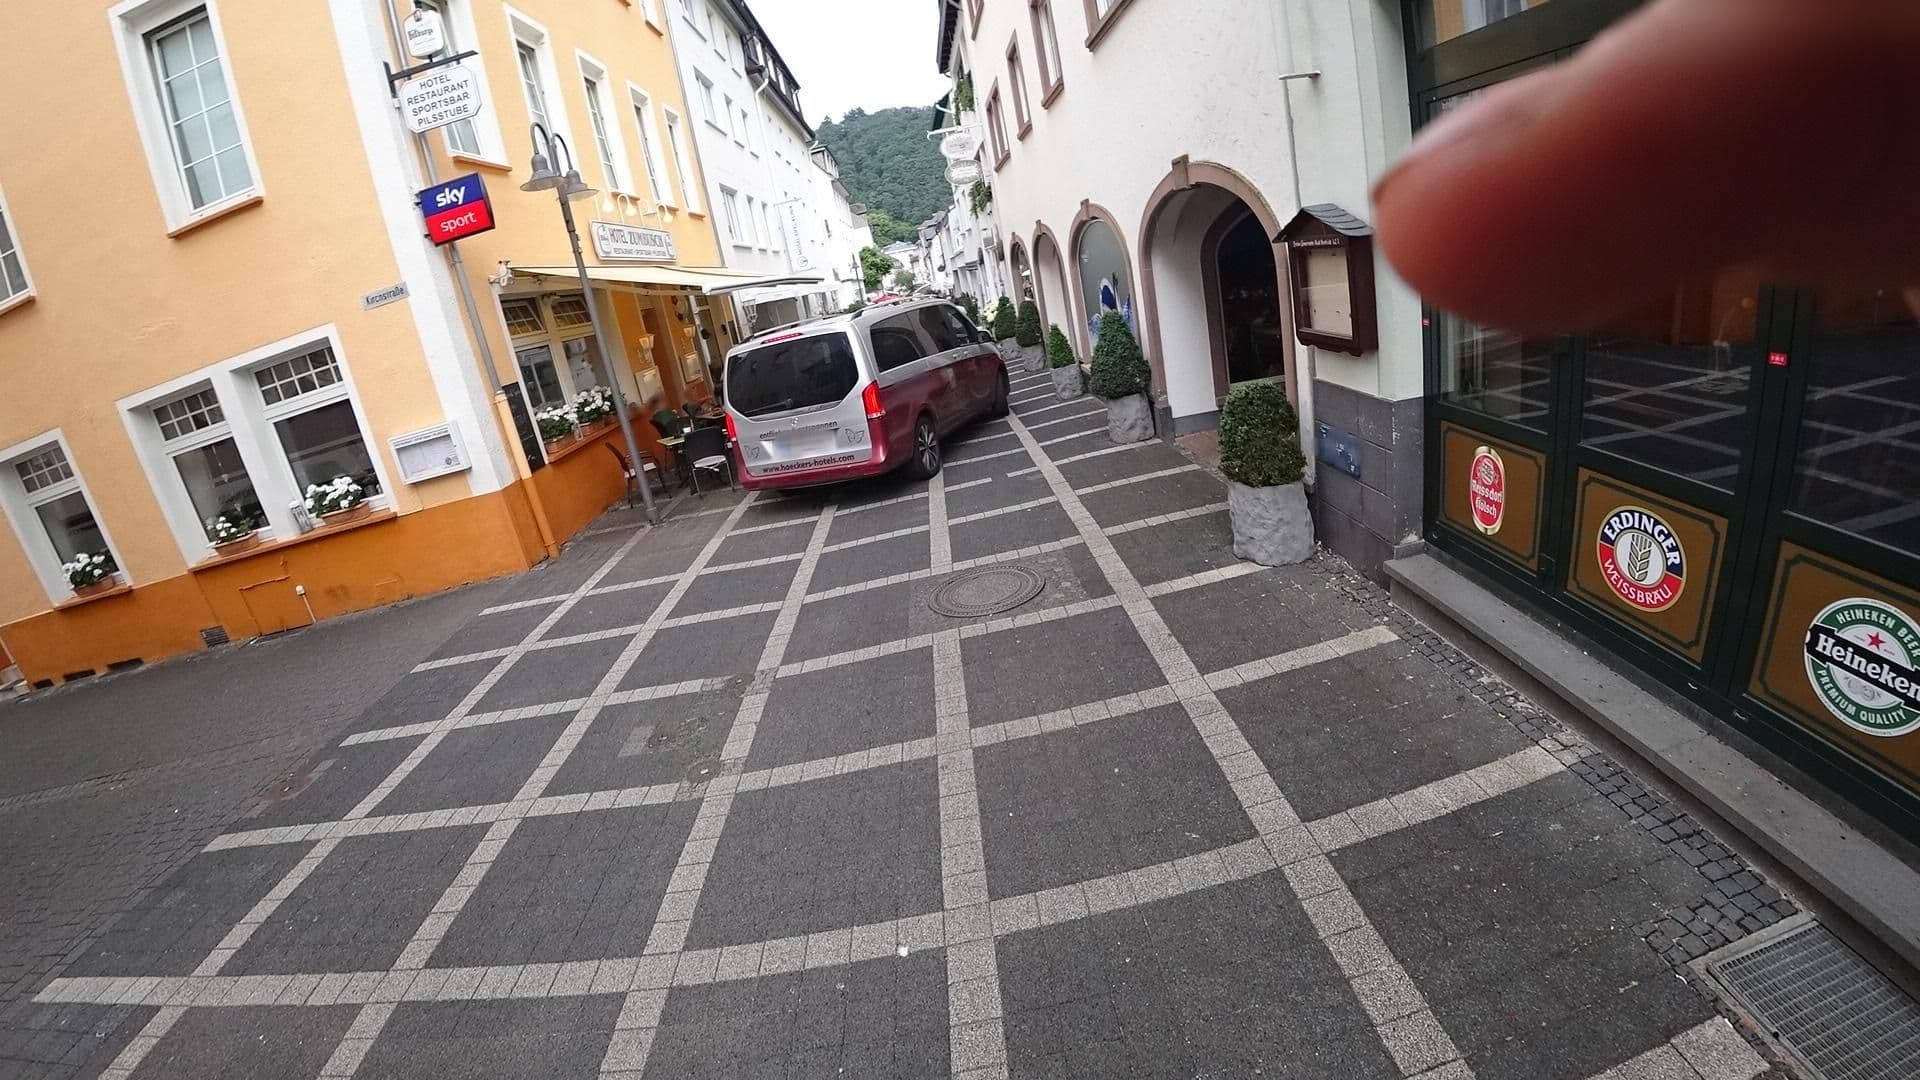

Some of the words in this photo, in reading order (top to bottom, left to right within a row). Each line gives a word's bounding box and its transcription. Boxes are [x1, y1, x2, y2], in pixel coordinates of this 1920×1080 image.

[407, 80, 469, 106] RESTAURANT
[419, 74, 451, 90] HOTEL
[412, 91, 470, 117] SPORTSBAR
[417, 104, 470, 127] PILSSTUBE
[435, 186, 466, 207] sky
[440, 212, 477, 232] sport
[366, 286, 404, 306] Kirchstraße
[1603, 511, 1681, 566] ERDINGER
[1835, 608, 1896, 629] HEINEKEN
[1815, 633, 1920, 701] Heineken
[1817, 669, 1857, 715] PREMIUM
[1859, 708, 1907, 725] QUALITY
